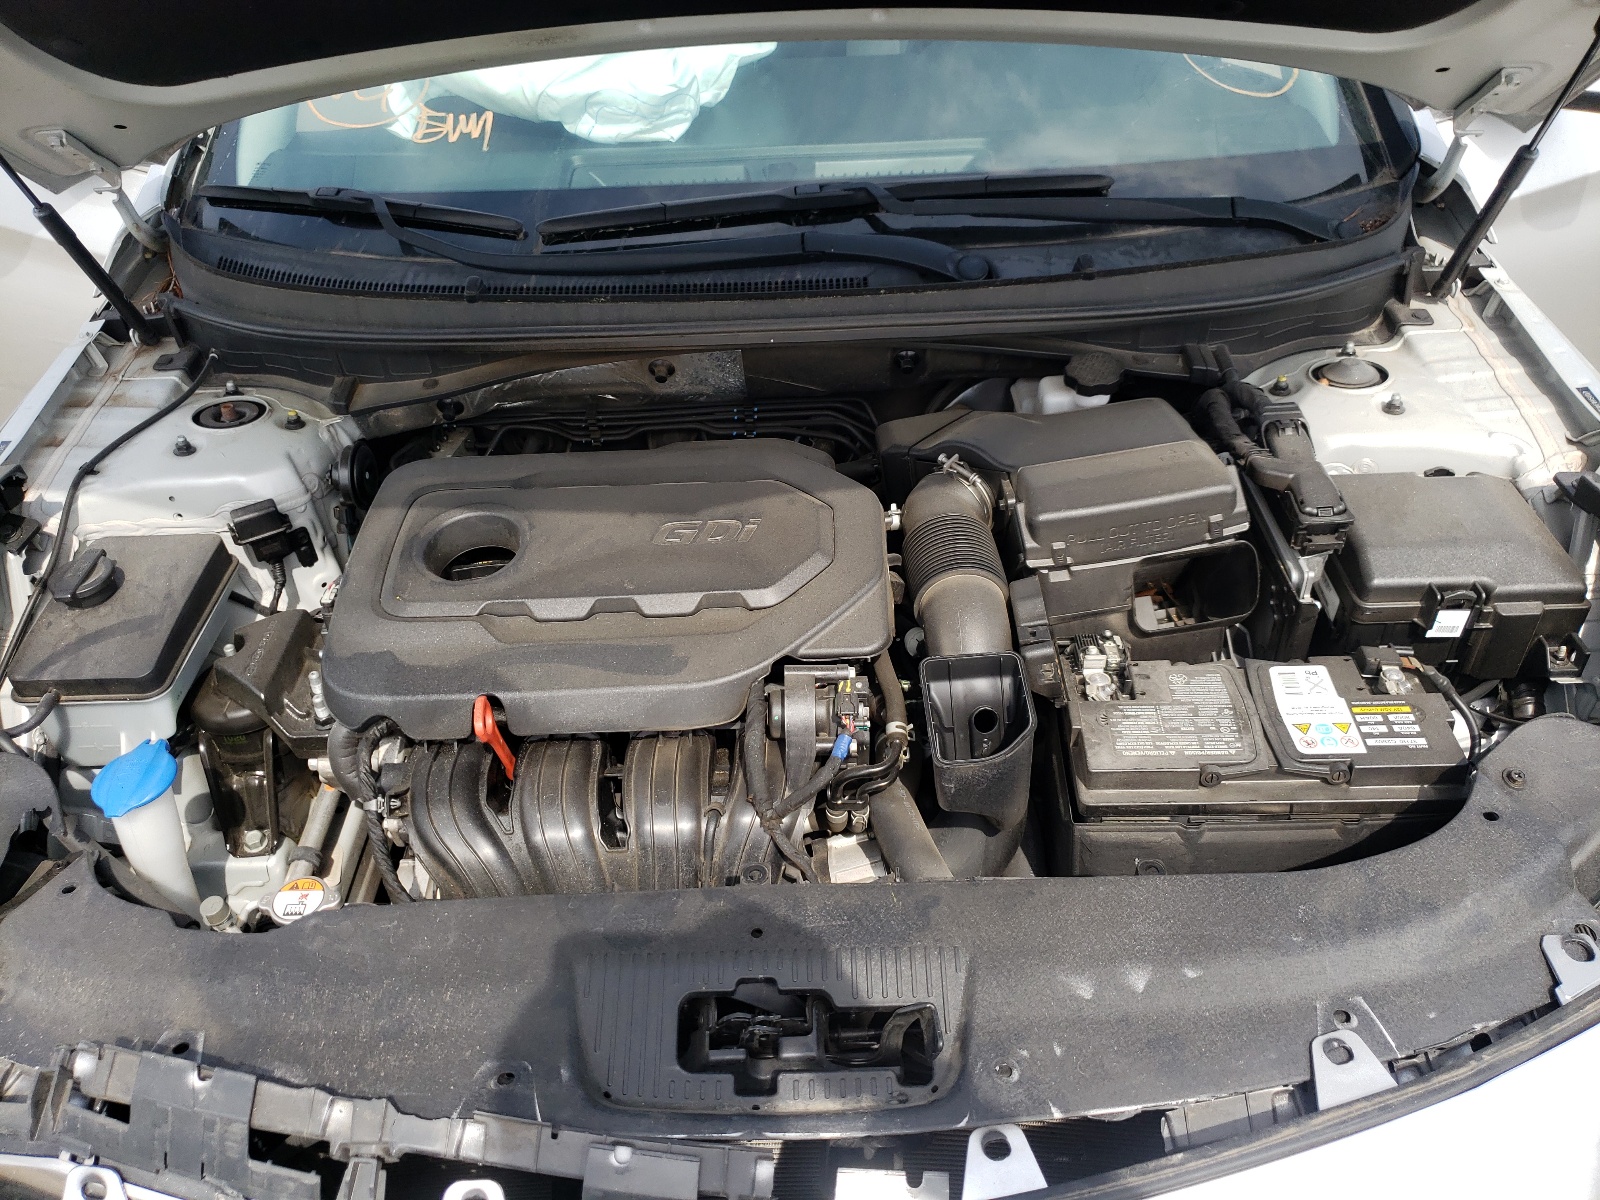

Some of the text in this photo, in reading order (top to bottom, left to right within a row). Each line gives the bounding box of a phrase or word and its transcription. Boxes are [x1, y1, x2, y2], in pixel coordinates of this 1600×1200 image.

[652, 518, 762, 546] GDi
[1067, 514, 1206, 546] PULL OUT TO OPEN
